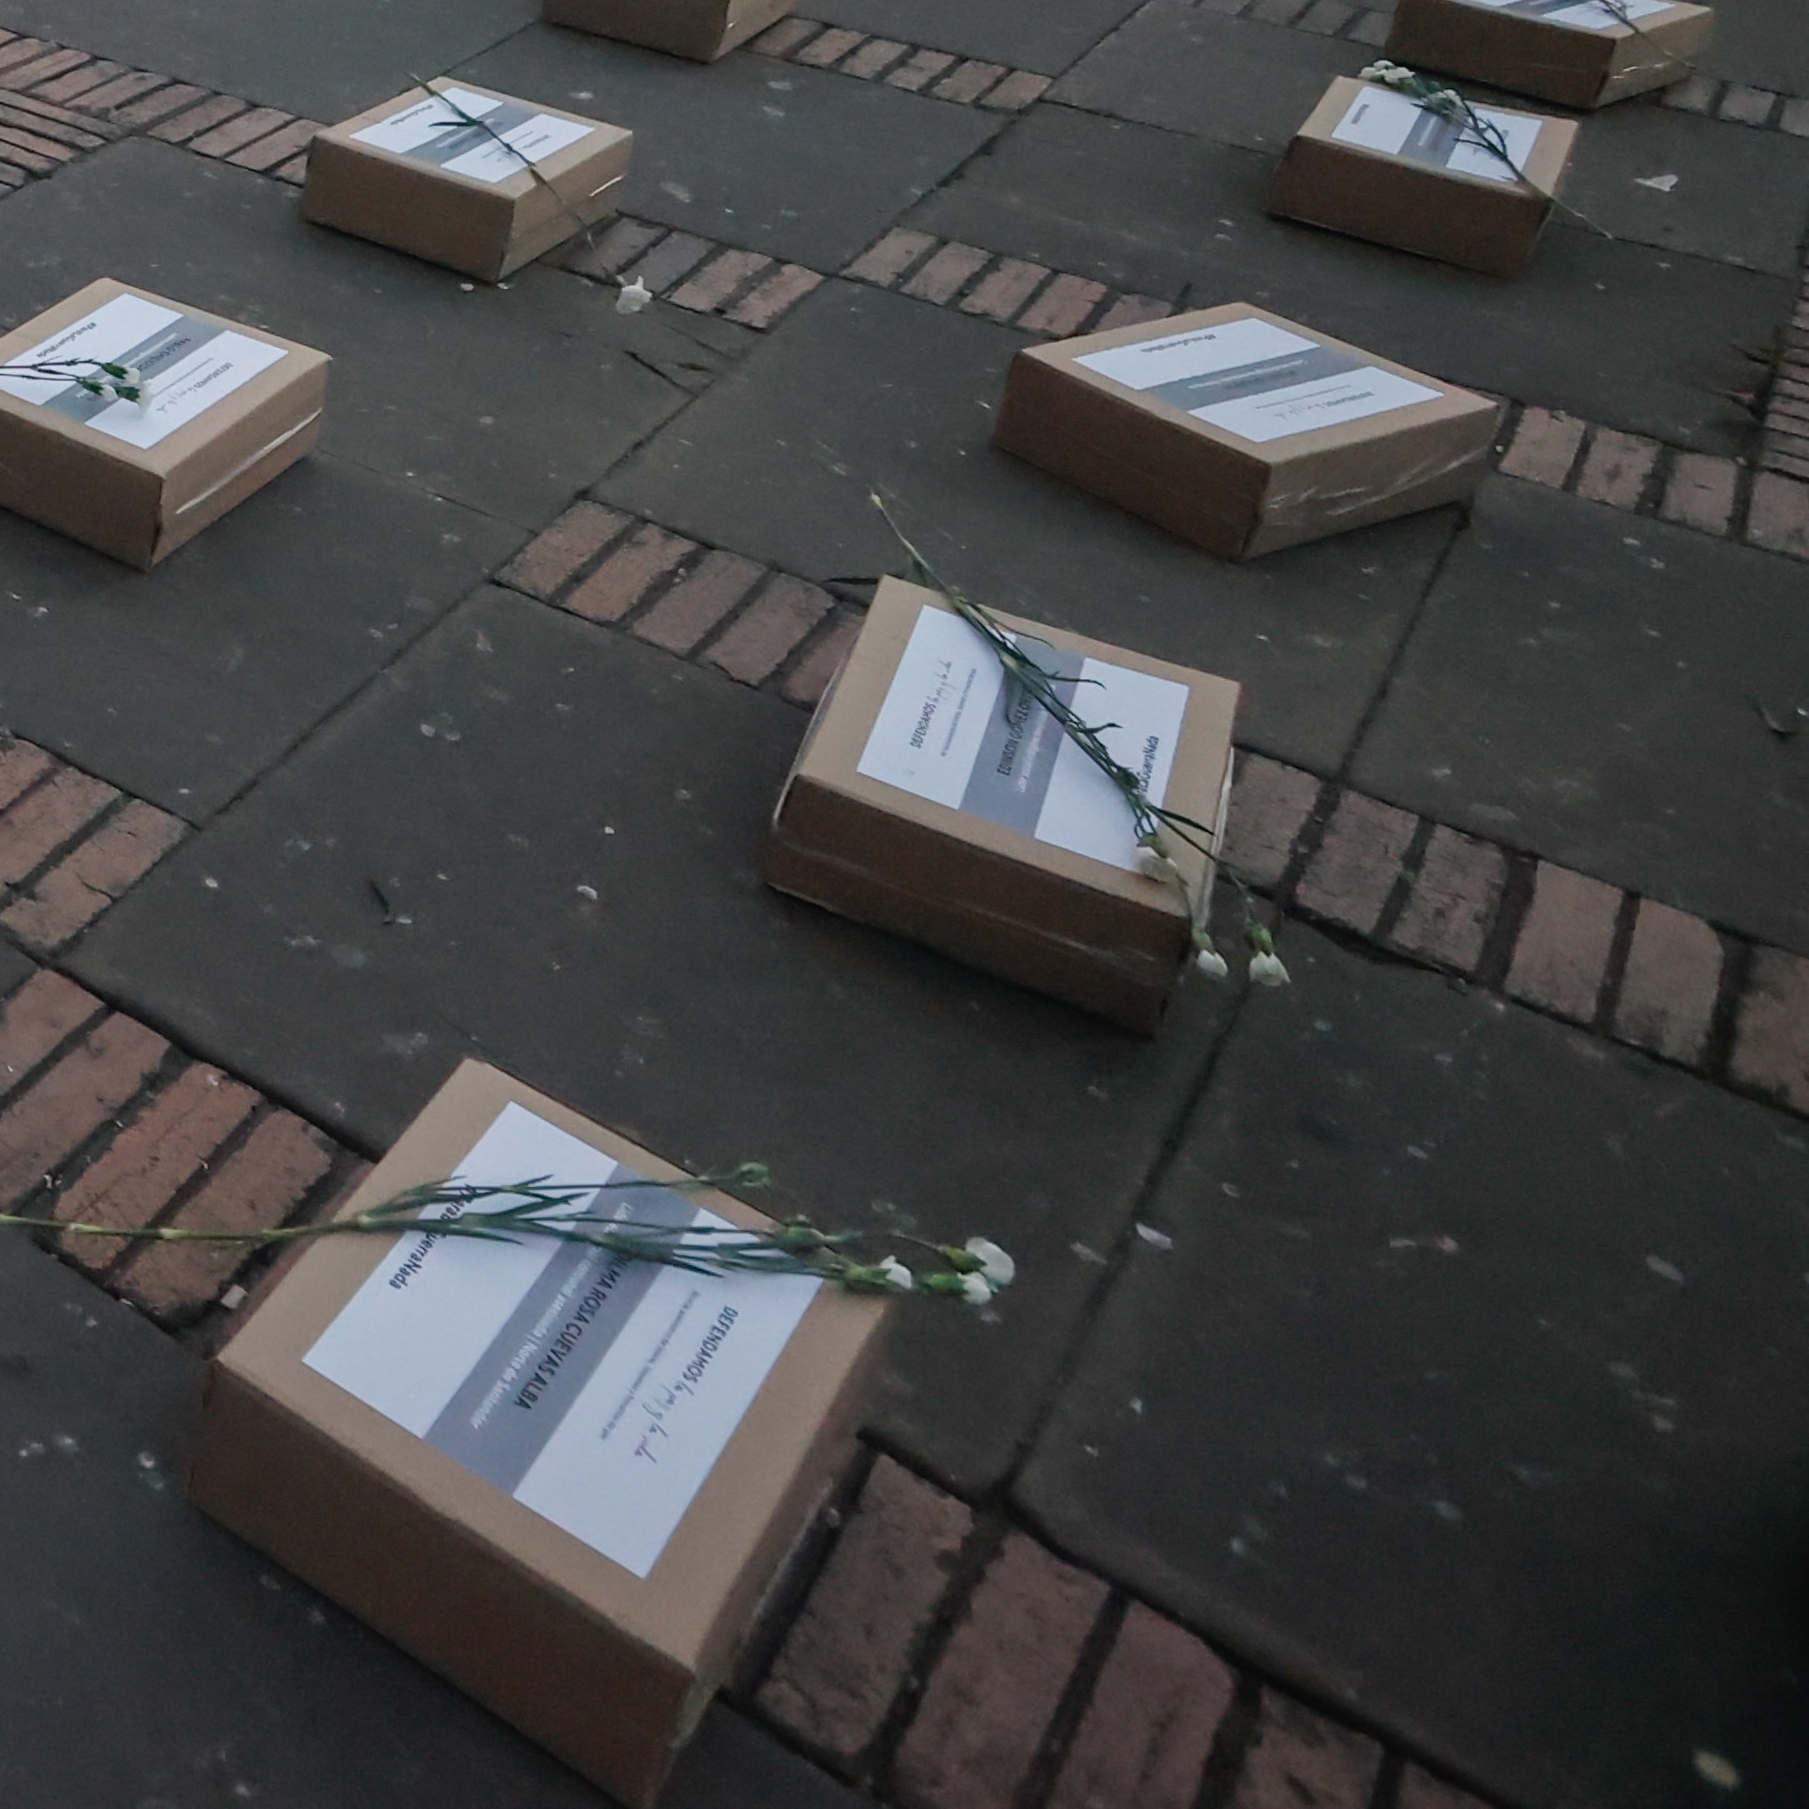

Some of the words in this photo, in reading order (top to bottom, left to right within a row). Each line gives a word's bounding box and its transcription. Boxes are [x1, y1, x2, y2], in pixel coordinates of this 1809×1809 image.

[570, 1286, 608, 1326] ROSA
[535, 1320, 585, 1378] CUEVAS
[679, 1304, 740, 1385] DEFENDAMOS
[510, 1370, 550, 1413] ALBA
